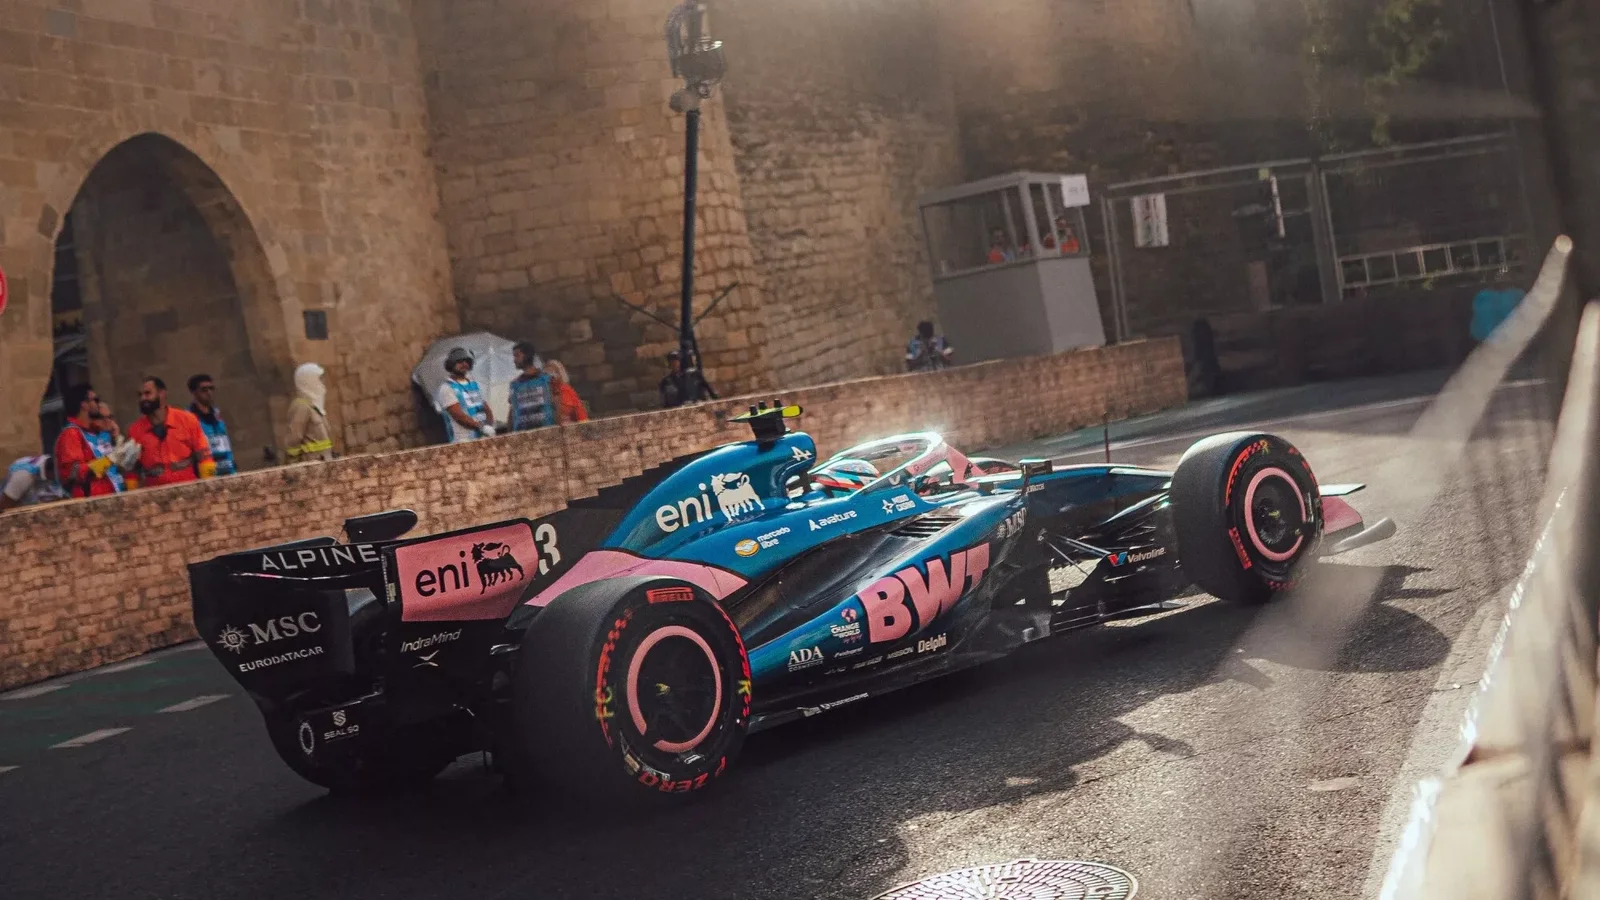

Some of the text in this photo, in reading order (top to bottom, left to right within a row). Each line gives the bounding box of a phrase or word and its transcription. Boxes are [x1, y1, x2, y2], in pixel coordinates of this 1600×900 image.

[655, 483, 713, 533] eni
[818, 510, 858, 527] avature
[757, 526, 791, 542] mercado
[760, 538, 779, 549] libre
[262, 544, 380, 571] ALPINE
[535, 523, 561, 575] 3
[1127, 547, 1166, 564] Valvoline
[415, 550, 469, 597] eni
[856, 542, 990, 643] BWT
[248, 611, 322, 645] MSC
[400, 628, 462, 652] IndraMind
[918, 632, 947, 653] Delphi
[239, 646, 324, 672] EURODATACAR
[788, 645, 825, 666] ADA
[638, 772, 709, 793] ZERO
